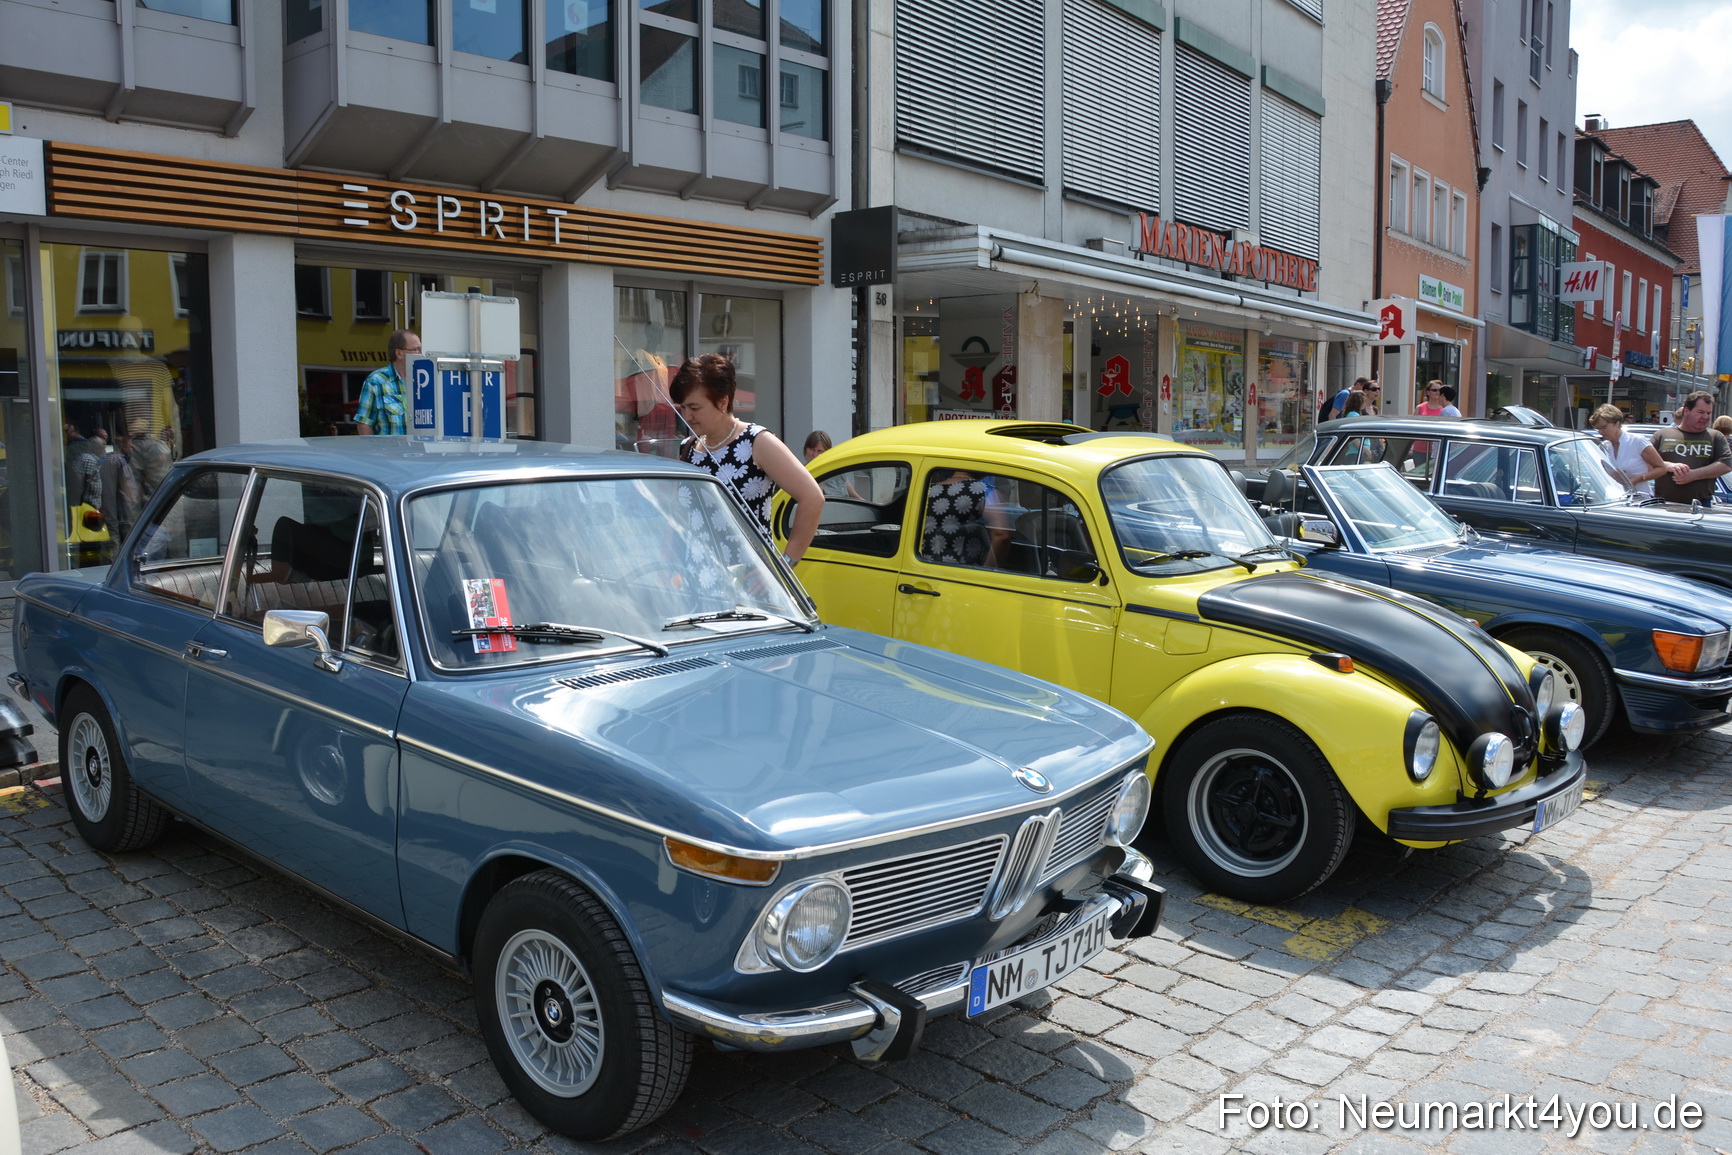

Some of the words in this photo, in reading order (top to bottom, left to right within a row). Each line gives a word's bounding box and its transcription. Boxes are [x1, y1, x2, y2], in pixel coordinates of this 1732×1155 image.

[12, 168, 33, 180] Riedl
[342, 183, 568, 245] ESPRIT
[841, 269, 886, 283] ESPRIT
[1564, 269, 1599, 293] H&M
[875, 291, 887, 306] 38
[416, 368, 430, 400] P
[414, 408, 433, 425] SCHEINE
[986, 958, 1024, 1005] NM
